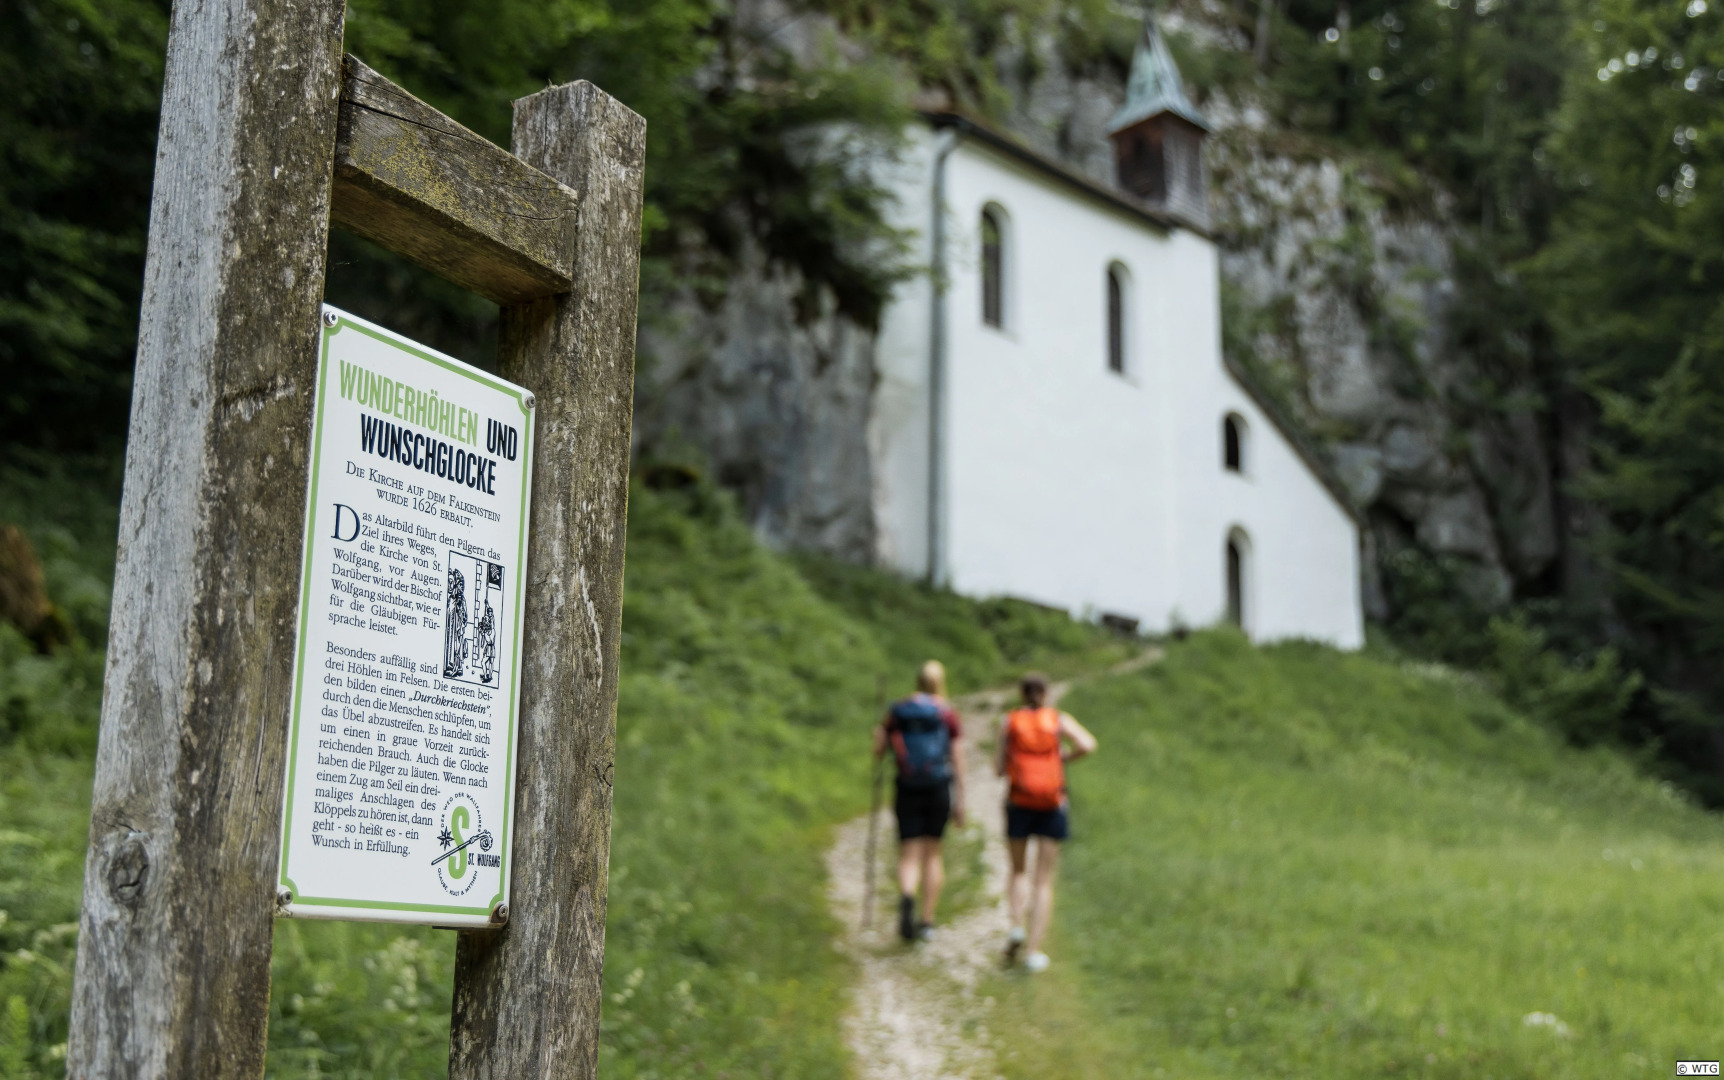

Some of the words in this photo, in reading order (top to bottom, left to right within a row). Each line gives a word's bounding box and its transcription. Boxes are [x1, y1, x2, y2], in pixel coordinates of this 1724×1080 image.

[340, 359, 478, 447] WUNDERHÖHLEN
[487, 418, 518, 461] UND
[361, 413, 497, 496] WUNSCHGLOCKE
[412, 497, 437, 516] 1626
[362, 525, 379, 539] Ziel
[382, 531, 404, 547] ihres
[408, 537, 437, 557] Weges,
[375, 515, 413, 534] Altarbild
[416, 525, 437, 542] führt
[439, 533, 454, 547] den
[457, 538, 485, 556] Pilgern
[488, 548, 501, 560] das
[333, 547, 382, 573] Wolfgang,
[389, 566, 405, 577] vor
[411, 570, 442, 587] Augen.
[361, 541, 375, 553] die
[379, 545, 409, 563] Kirche
[412, 557, 429, 569] von
[432, 561, 443, 572] St.
[331, 578, 376, 601] Wolfgang
[377, 590, 414, 611] sichtbar,
[416, 602, 431, 613] wie
[432, 607, 441, 617] er
[332, 563, 372, 583] Darüber
[373, 575, 393, 589] wird
[395, 579, 409, 592] der
[410, 584, 442, 602] Bischof
[328, 611, 366, 628] sprache
[369, 619, 398, 636] leistet.
[330, 595, 344, 608] für
[350, 600, 365, 612] die
[371, 604, 417, 625] Gläubigen
[423, 617, 440, 631] Für-
[326, 641, 376, 662] Besonders
[380, 654, 416, 673] auffällig
[420, 663, 437, 675] sind
[324, 673, 342, 686] den
[347, 677, 376, 693] bilden
[380, 686, 406, 699] einen
[325, 657, 344, 671] drei
[348, 661, 382, 679] Höhlen
[386, 670, 397, 682] im
[400, 672, 430, 688] Felsen.
[433, 679, 448, 692] Die
[451, 685, 475, 698] ersten
[478, 688, 493, 701] bei-
[321, 705, 338, 718] das
[342, 706, 364, 723] Übel
[368, 713, 425, 733] abzustreifen.
[428, 724, 438, 735] Es
[441, 726, 472, 741] handelt
[474, 732, 490, 745] sich
[322, 689, 351, 704] durch
[353, 695, 371, 707] den
[373, 697, 387, 710] die
[389, 701, 433, 720] Menschen
[435, 711, 477, 729] schlüpfen,
[479, 719, 491, 730] um
[319, 737, 373, 756] reichenden
[378, 746, 412, 761] Brauch.
[416, 753, 439, 766] Auch
[443, 755, 456, 768] die
[460, 757, 489, 774] Glocke
[320, 722, 336, 734] um
[343, 725, 370, 740] einen
[377, 731, 386, 742] in
[393, 736, 418, 747] graue
[424, 738, 453, 753] Vorzeit
[459, 744, 489, 759] zurück-
[316, 770, 347, 784] einem
[350, 773, 368, 789] Zug
[370, 780, 384, 789] am
[387, 779, 403, 792] Seil
[405, 782, 418, 793] ein
[421, 784, 441, 797] drei-
[318, 752, 348, 768] haben
[351, 757, 366, 770] die
[369, 760, 395, 776] Pilger
[398, 766, 408, 776] zu
[411, 766, 440, 781] läuten.
[443, 771, 466, 785] Wenn
[468, 776, 488, 788] nach
[314, 801, 356, 818] Klöppels
[357, 808, 369, 818] zu
[370, 807, 396, 822] hören
[398, 813, 410, 824] ist,
[411, 813, 433, 826] dann
[315, 786, 354, 802] maliges
[360, 791, 414, 810] Anschlagen
[421, 797, 436, 811] des
[312, 819, 334, 832] geht
[345, 823, 356, 833] so
[359, 822, 383, 836] heißt
[386, 828, 395, 837] es
[405, 829, 418, 839] ein
[312, 834, 350, 849] Wunsch
[354, 838, 363, 850] in
[366, 839, 410, 857] Erfüllung.
